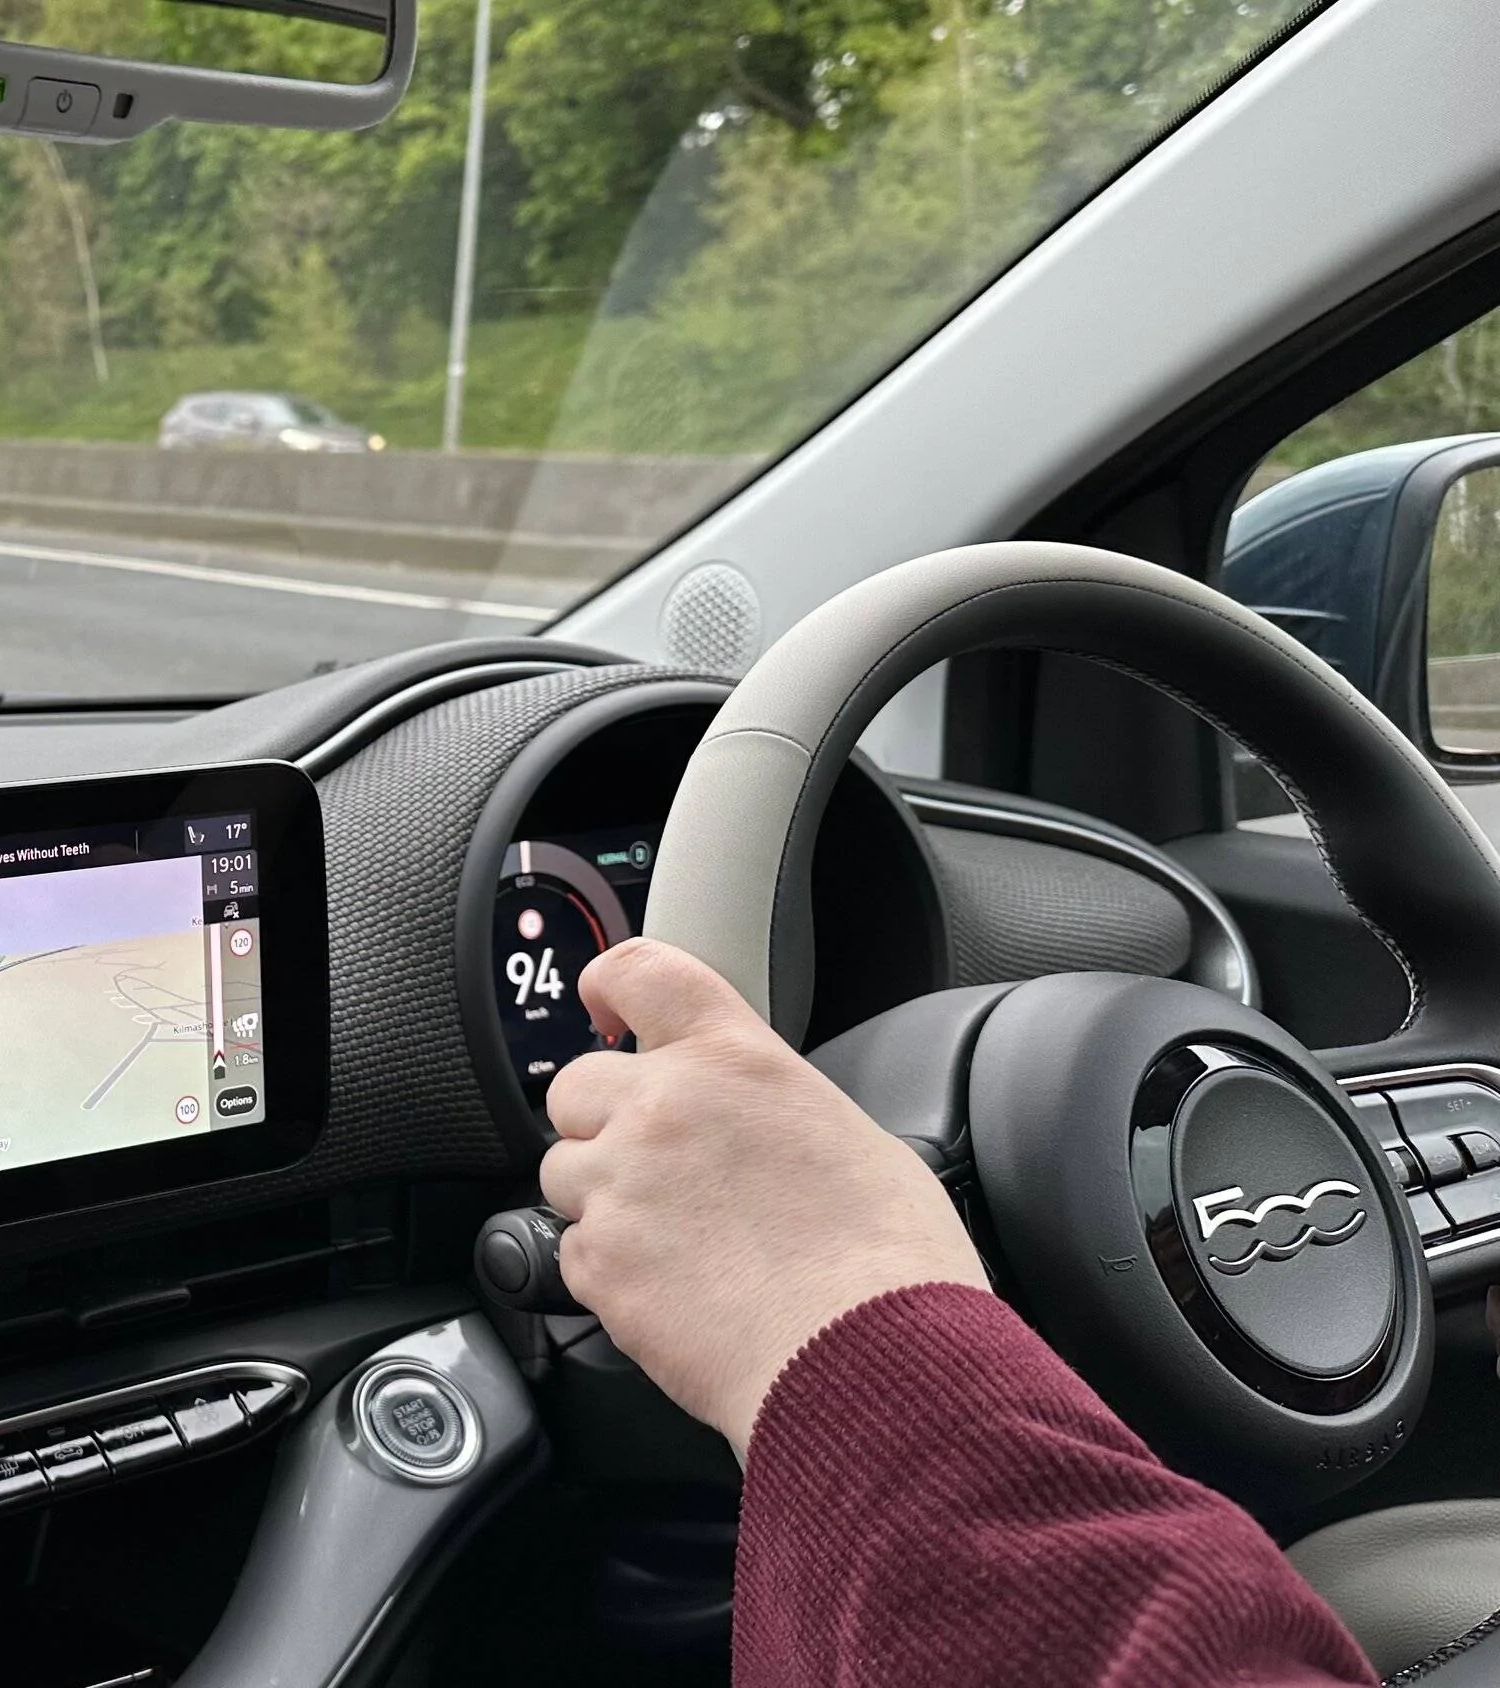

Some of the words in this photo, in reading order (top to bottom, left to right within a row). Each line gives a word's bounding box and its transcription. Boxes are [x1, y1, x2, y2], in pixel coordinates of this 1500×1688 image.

[16, 846, 59, 862] Without
[59, 842, 90, 857] Teeth
[211, 854, 252, 874] 19:01
[234, 937, 248, 948] 120
[506, 947, 565, 1005] 94
[179, 1104, 196, 1115] 100
[220, 1095, 253, 1110] Options
[393, 1398, 425, 1418] START
[408, 1417, 435, 1436] STOP
